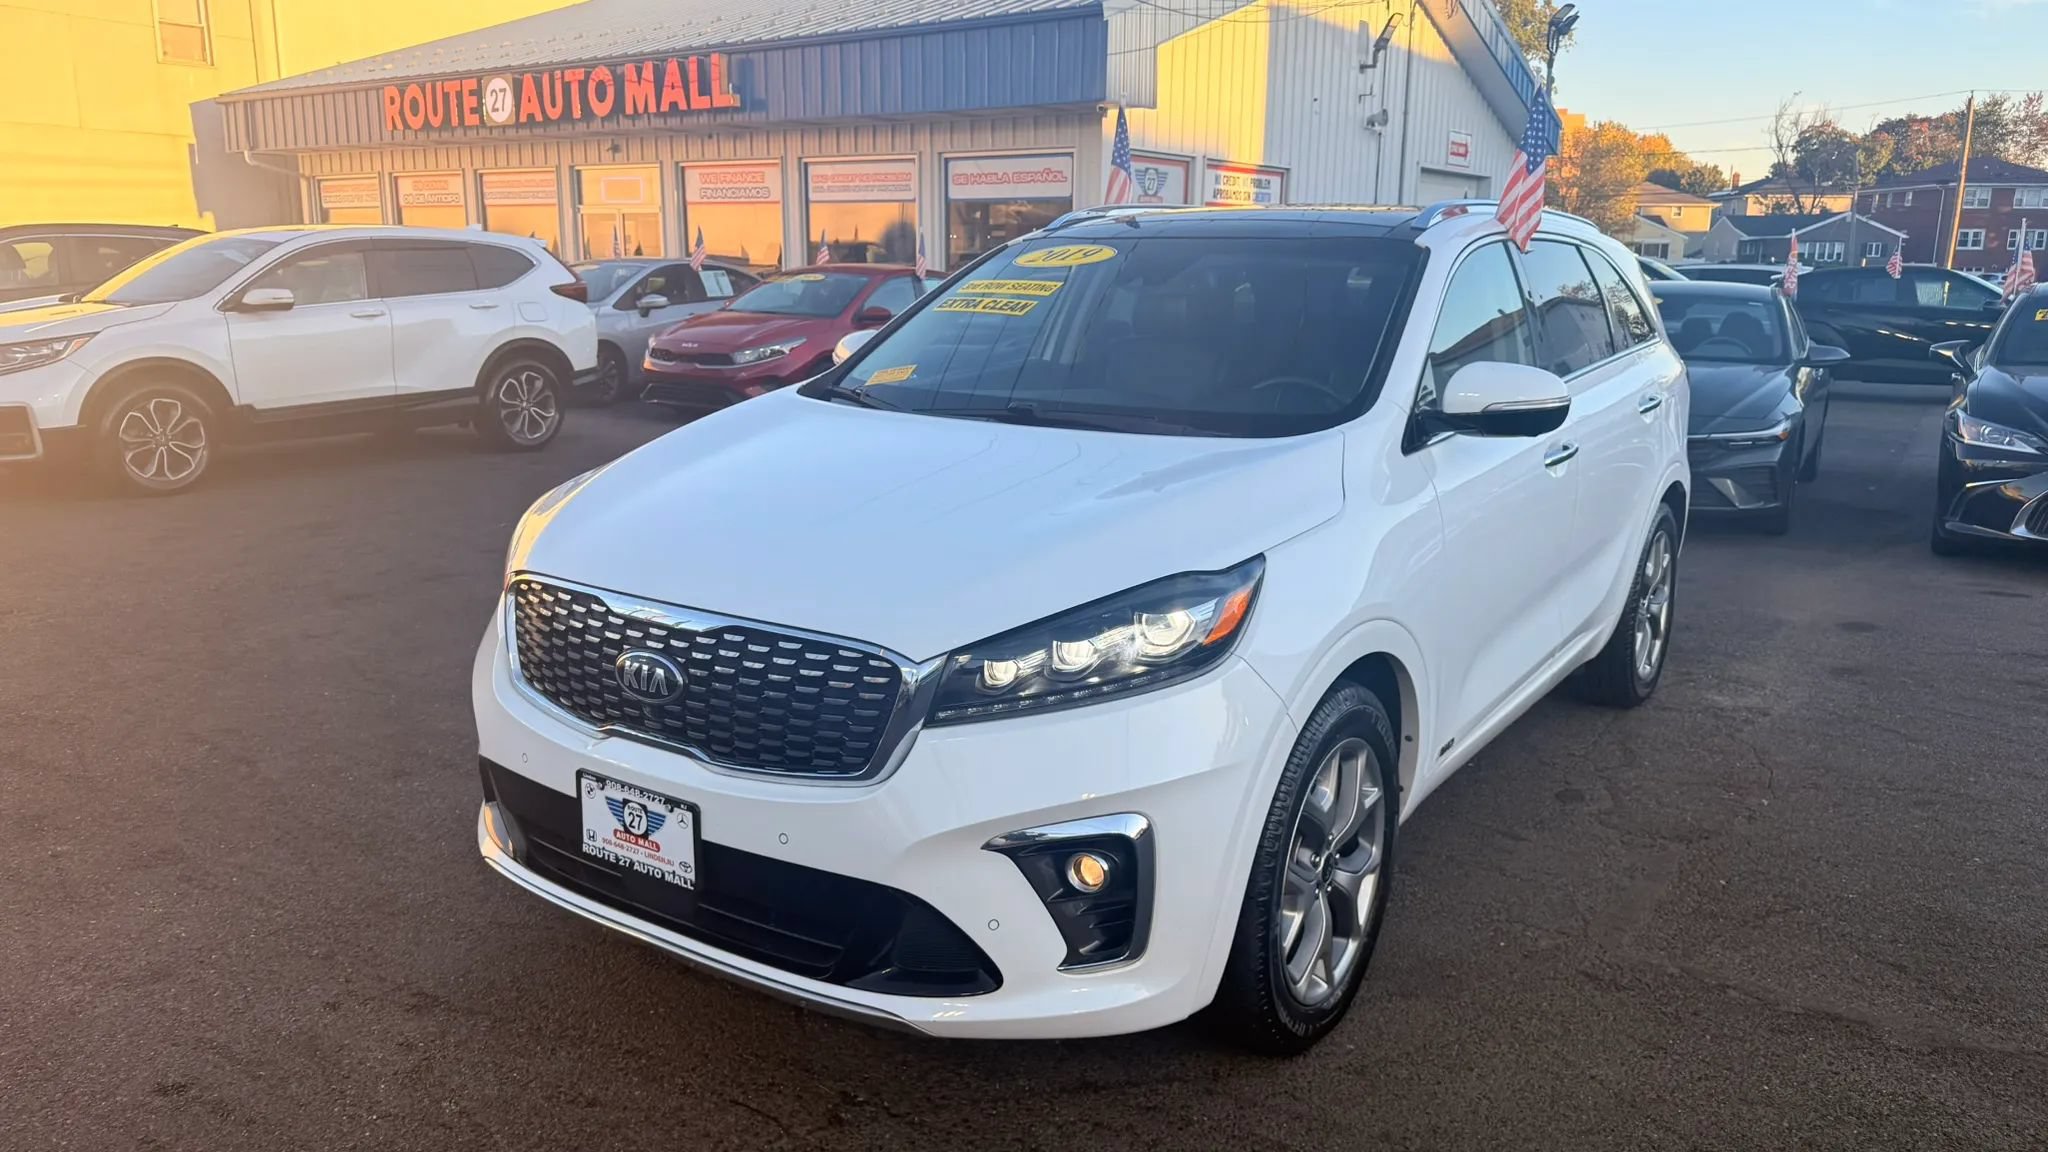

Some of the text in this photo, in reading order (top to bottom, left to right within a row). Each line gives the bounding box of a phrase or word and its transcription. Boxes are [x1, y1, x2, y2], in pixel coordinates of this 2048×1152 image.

[384, 52, 738, 130] ROUTE 27 AUTO MALL
[699, 171, 765, 184] WE FINANCE
[970, 172, 1010, 185] HABLA
[1012, 168, 1068, 184] ESPAÑOL
[700, 186, 771, 199] FINANCIAMOS
[1007, 282, 1058, 292] SEATING
[938, 298, 1034, 313] EXTRA CLEAN
[624, 660, 669, 696] KIA
[606, 780, 665, 805] 908-648-2727
[627, 804, 643, 815] ROUTE
[628, 812, 643, 831] 27
[616, 830, 659, 852] AUTO MALL
[583, 843, 695, 890] ROUTE 27 AUTO MALL
